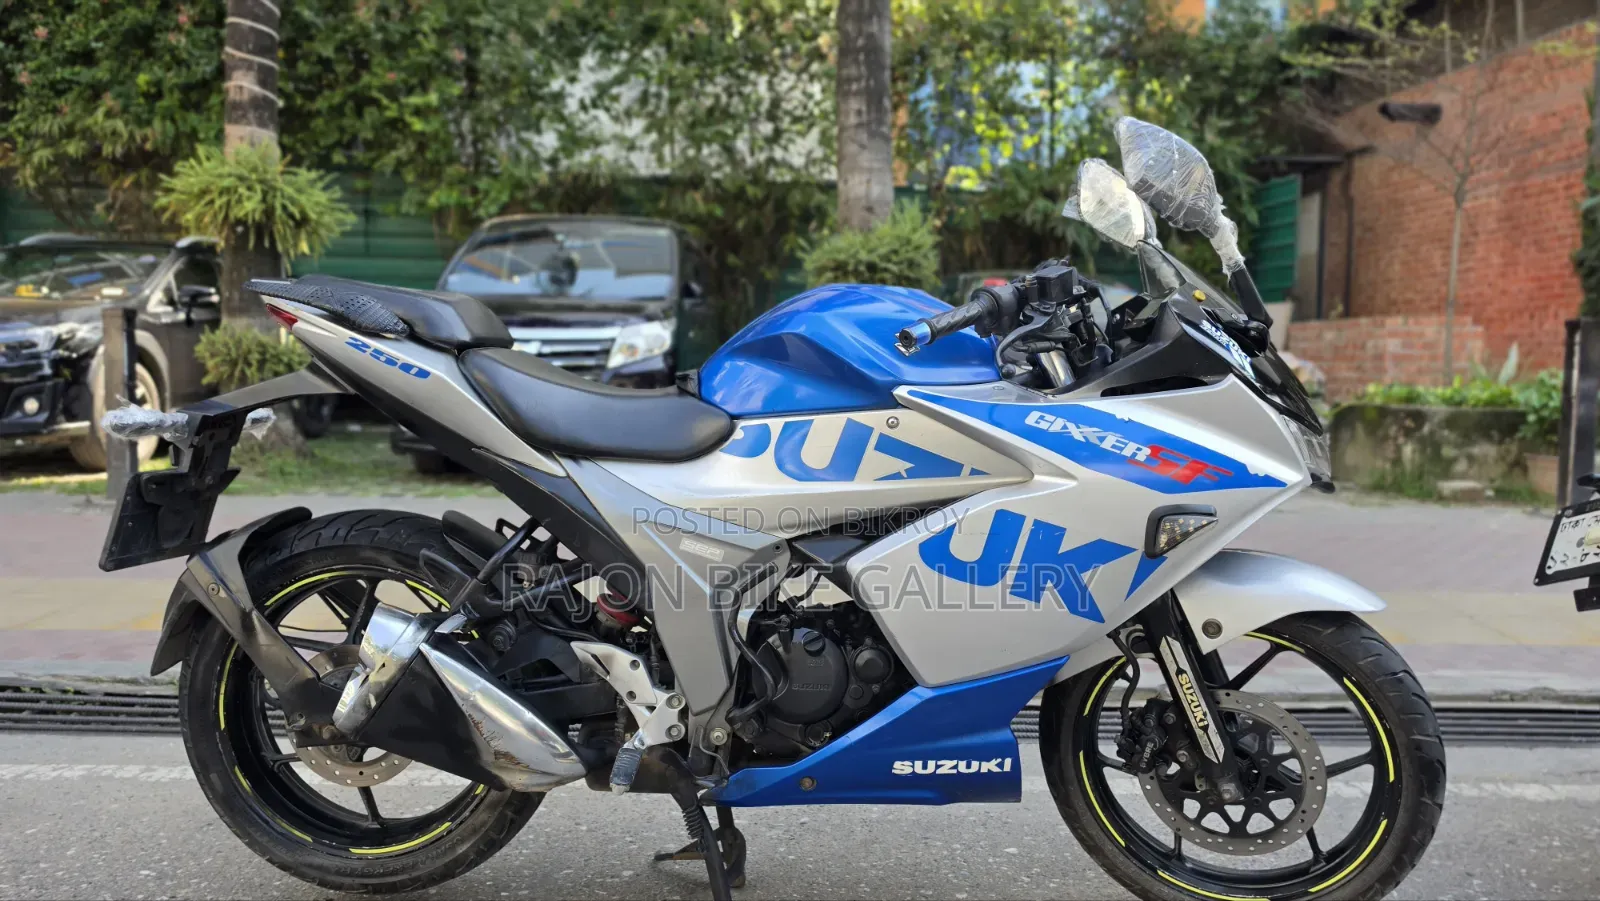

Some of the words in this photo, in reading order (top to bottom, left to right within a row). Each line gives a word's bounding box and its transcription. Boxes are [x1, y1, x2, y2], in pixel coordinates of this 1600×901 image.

[345, 336, 431, 379] 250
[1024, 410, 1152, 463] GIXXER
[1126, 444, 1234, 485] SF
[681, 539, 722, 559] SEP
[1178, 673, 1209, 728] SUZUKI
[892, 757, 1013, 776] SUZUKI
